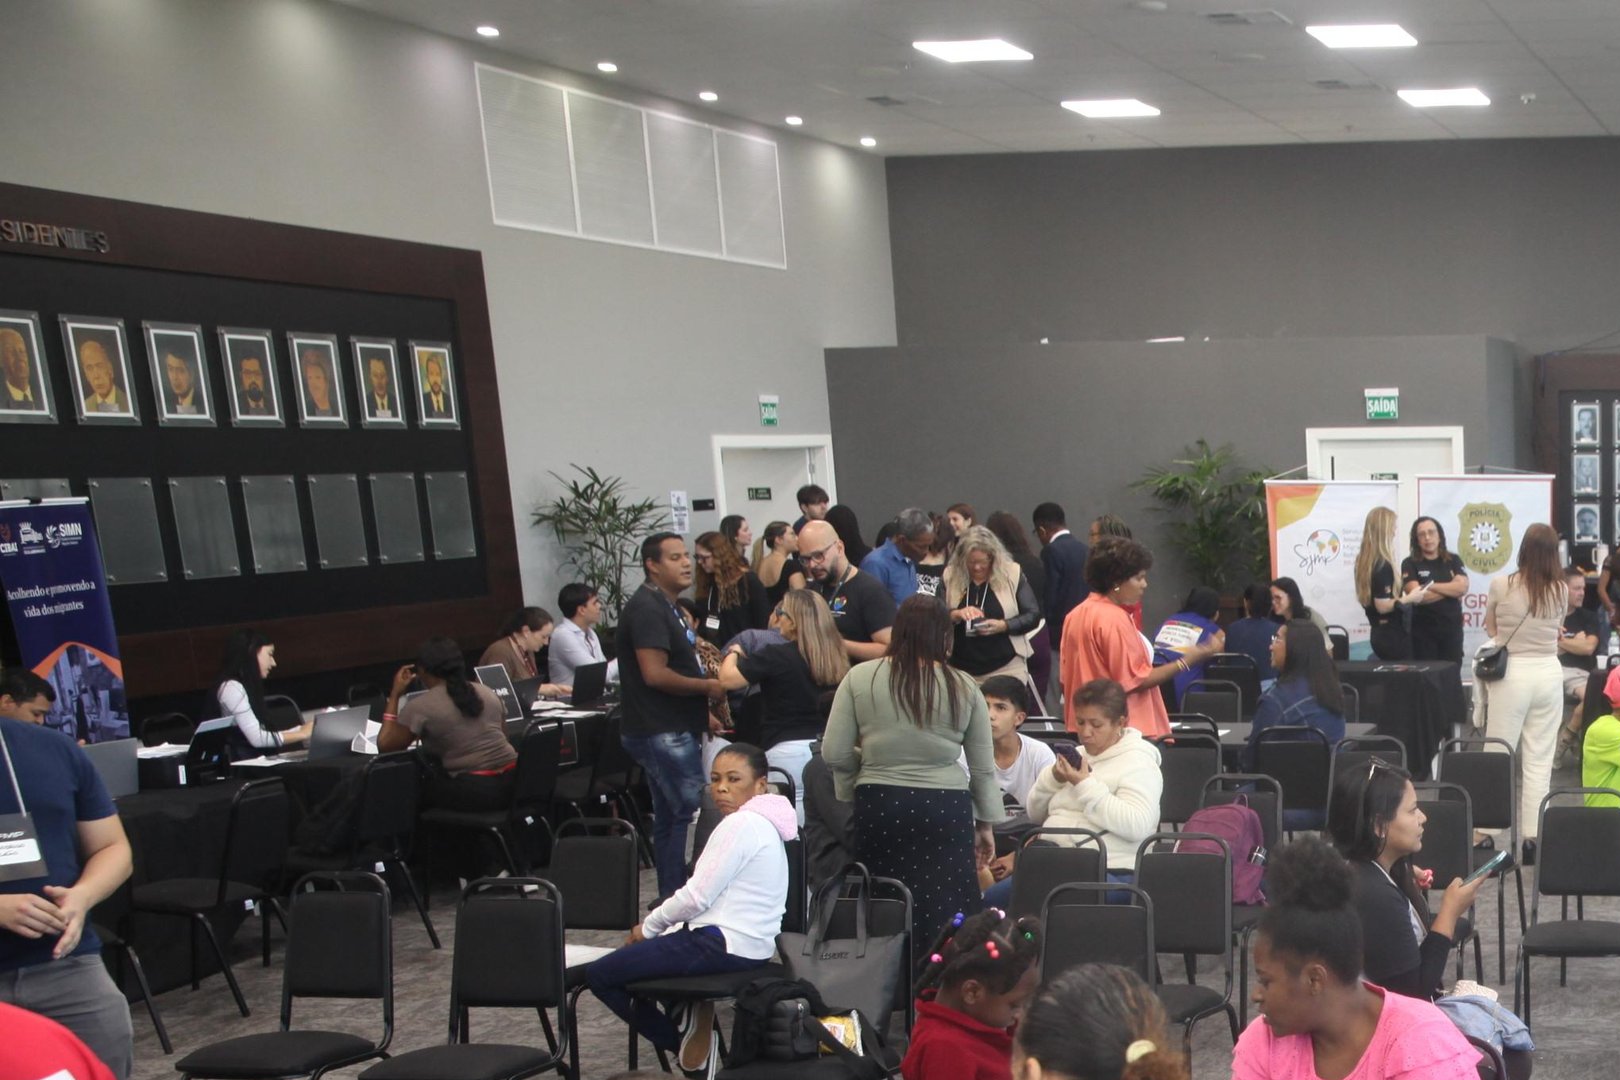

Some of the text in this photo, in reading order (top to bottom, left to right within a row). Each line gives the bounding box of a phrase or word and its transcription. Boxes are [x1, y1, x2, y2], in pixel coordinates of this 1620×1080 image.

[0, 219, 110, 253] SIDENTES
[1368, 397, 1396, 412] SAÍDA
[1469, 508, 1501, 519] POLÍCIA
[59, 523, 82, 537] SIMN
[1472, 559, 1497, 567] CIVIL
[24, 605, 41, 618] vida
